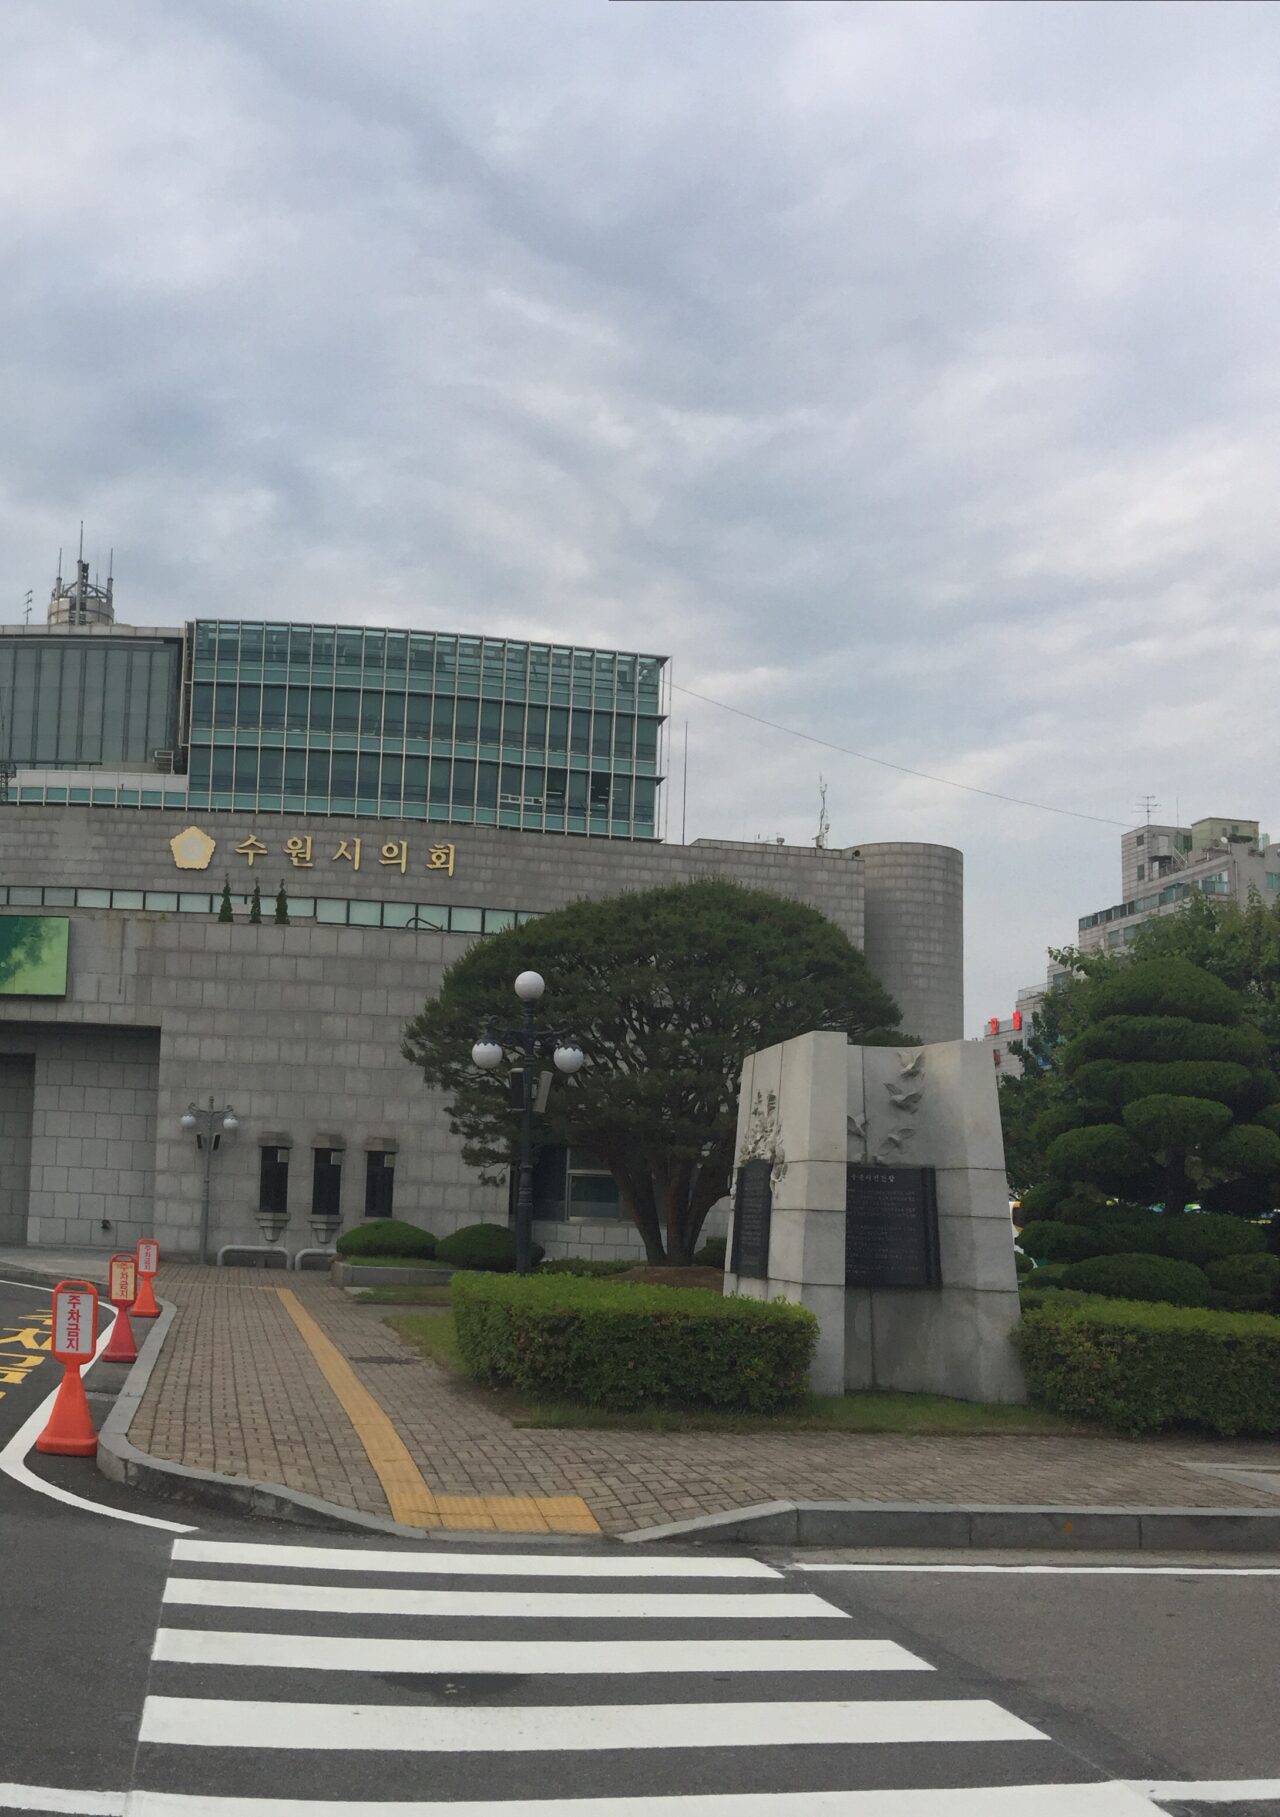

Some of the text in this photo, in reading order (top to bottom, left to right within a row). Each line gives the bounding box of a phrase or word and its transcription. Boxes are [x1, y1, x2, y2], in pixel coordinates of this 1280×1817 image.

[235, 834, 456, 877] 수원시의회
[119, 1262, 129, 1299] 주차금지
[65, 1295, 81, 1352] 주차금지
